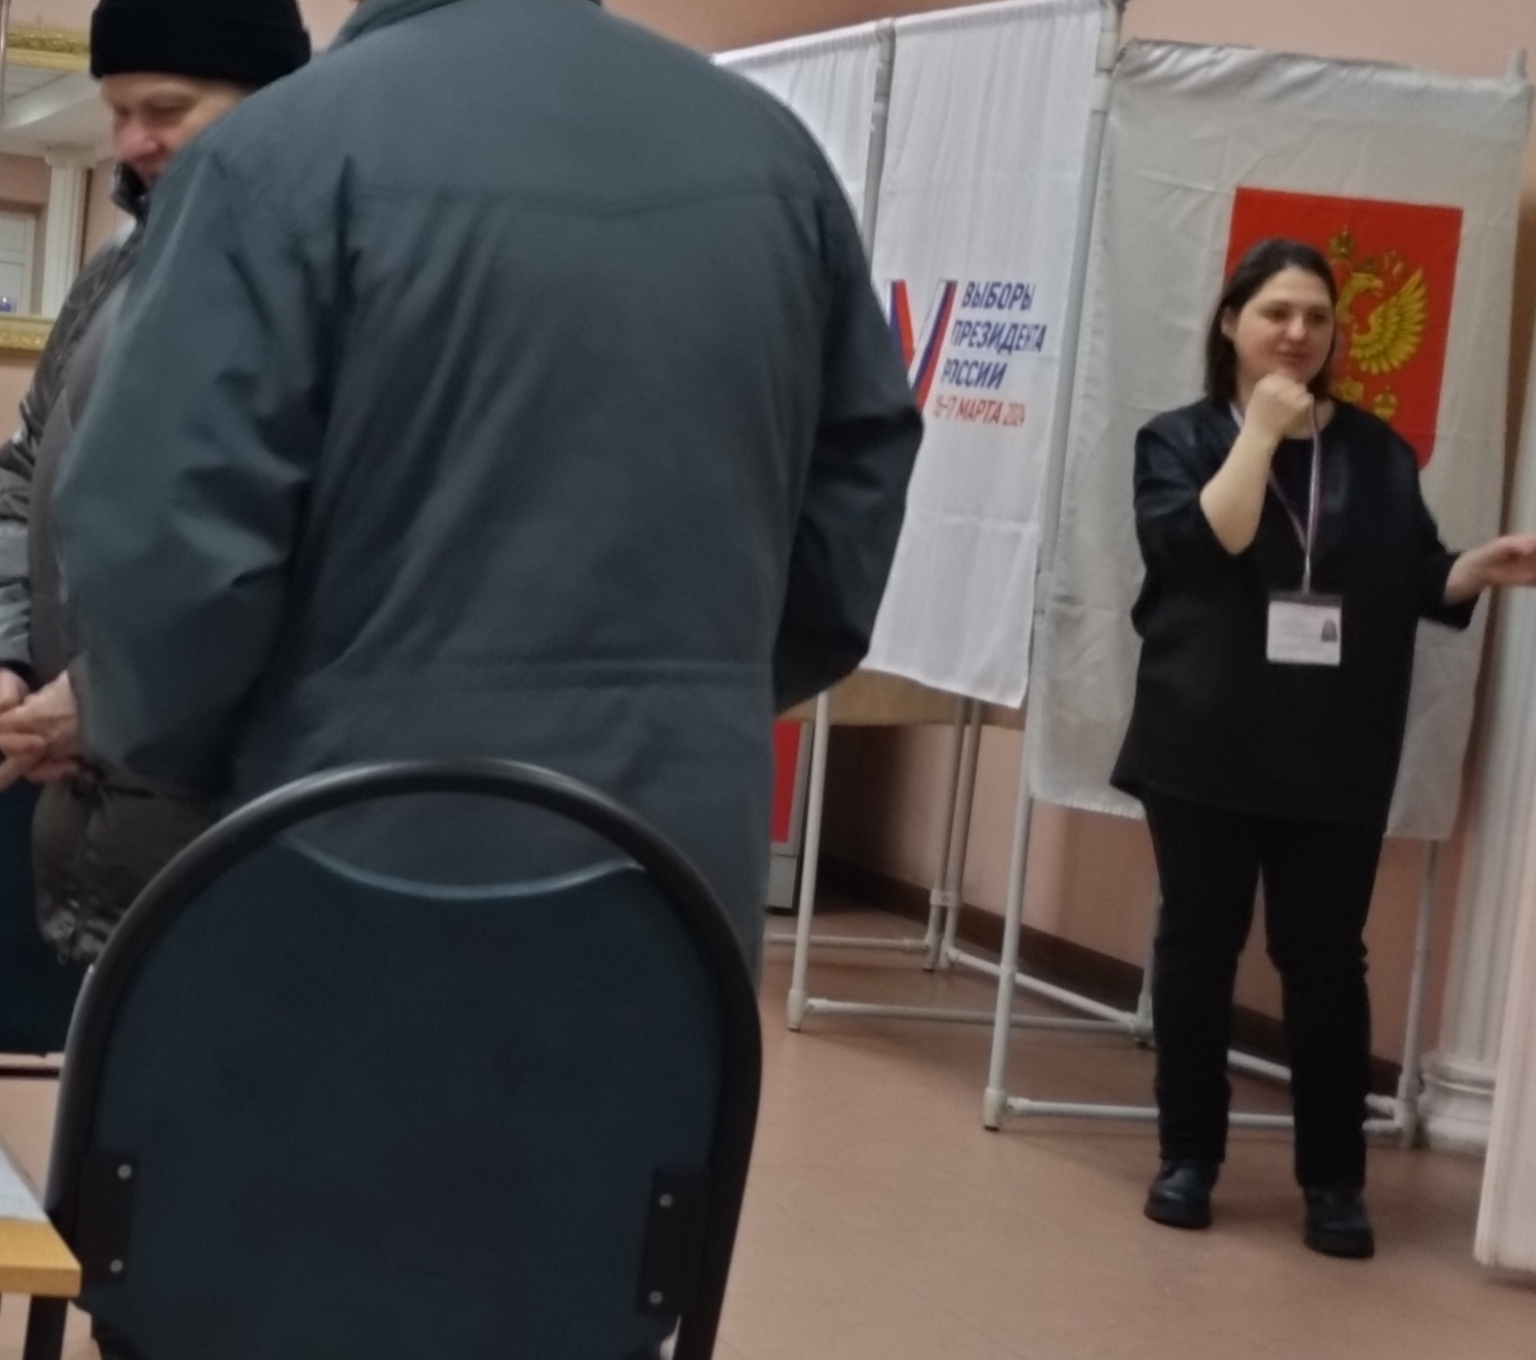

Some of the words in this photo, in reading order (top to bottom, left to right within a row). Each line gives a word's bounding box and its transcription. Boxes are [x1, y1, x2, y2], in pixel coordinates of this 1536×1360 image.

[961, 280, 1036, 312] ВЫБОРЫ
[950, 319, 1048, 356] ПРЕЗИДЕНТА
[939, 357, 1008, 390] РОССИИ
[957, 397, 1003, 426] МАРТА
